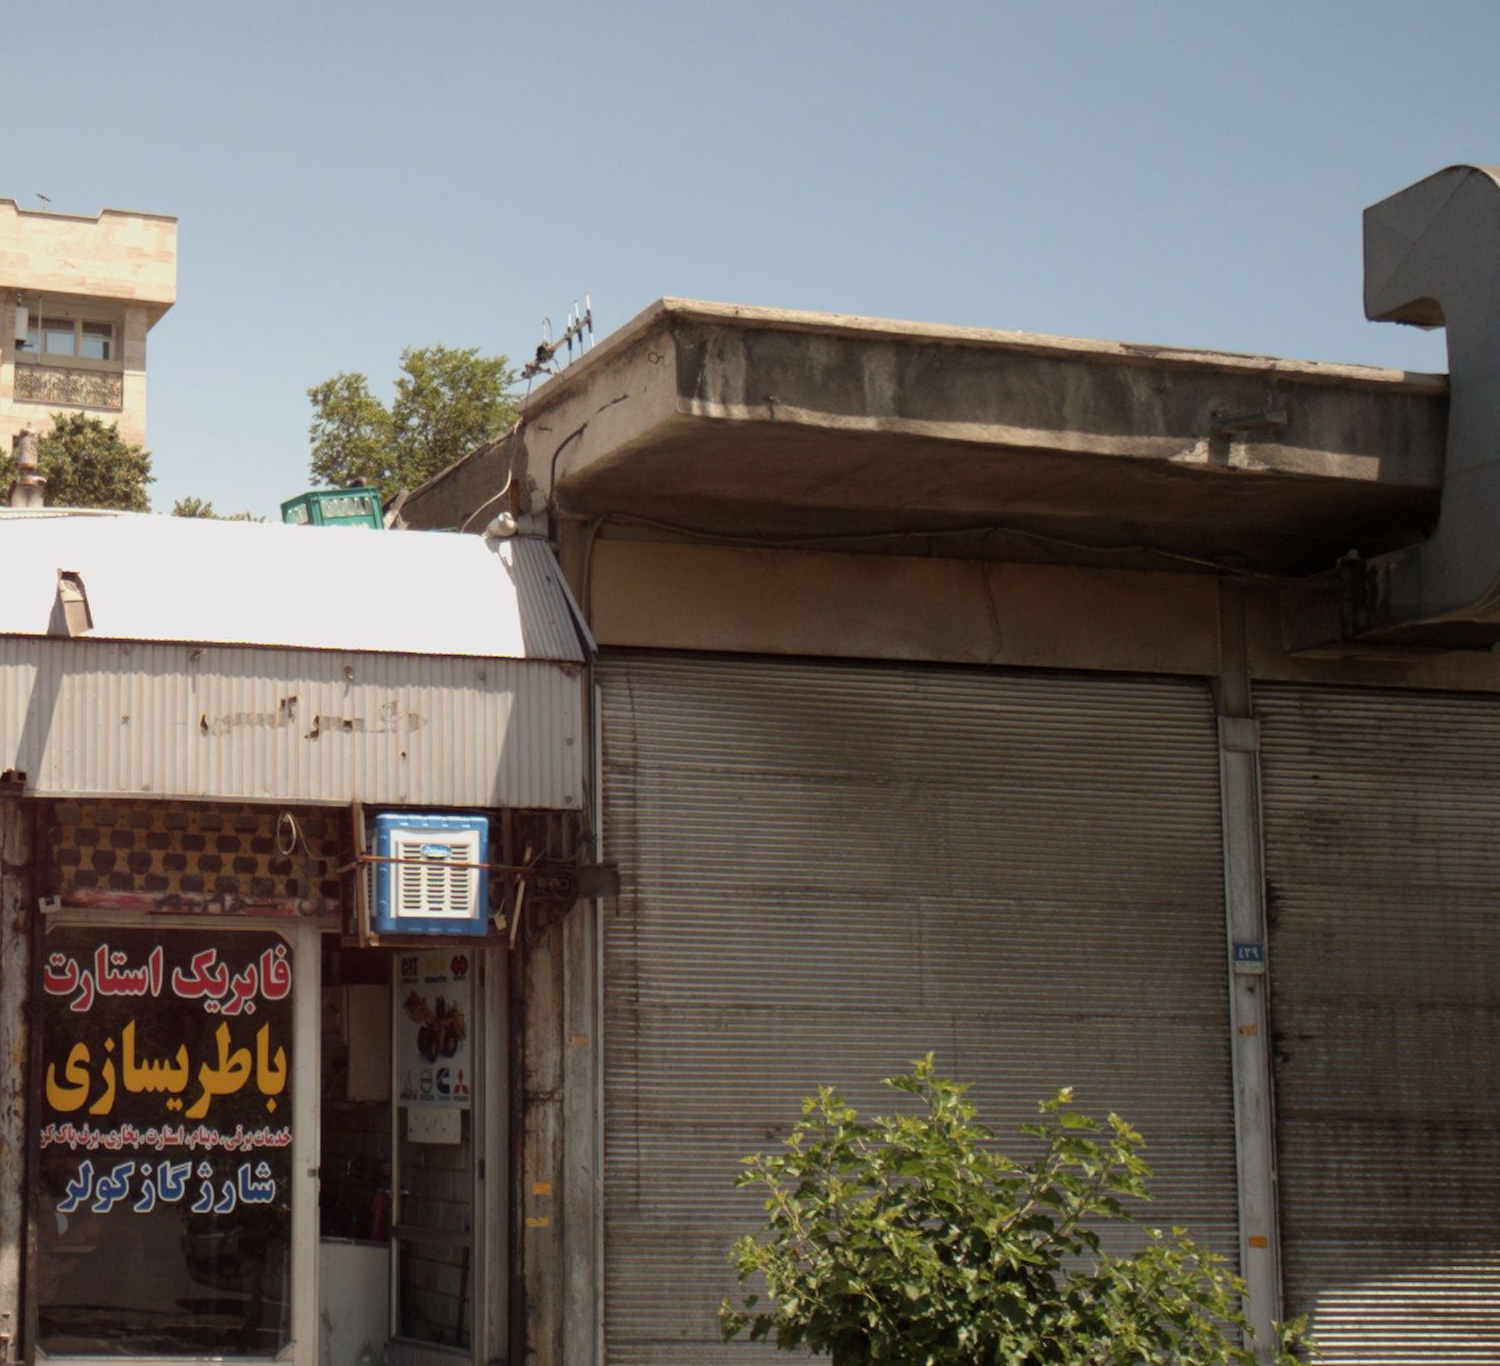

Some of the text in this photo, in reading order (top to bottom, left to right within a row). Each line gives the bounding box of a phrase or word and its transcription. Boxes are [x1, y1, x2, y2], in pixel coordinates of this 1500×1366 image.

[43, 944, 291, 1015] فابریک استارت
[46, 1019, 287, 1119] باطریسازی
[57, 1159, 276, 1213] شارژ گاز کولر
